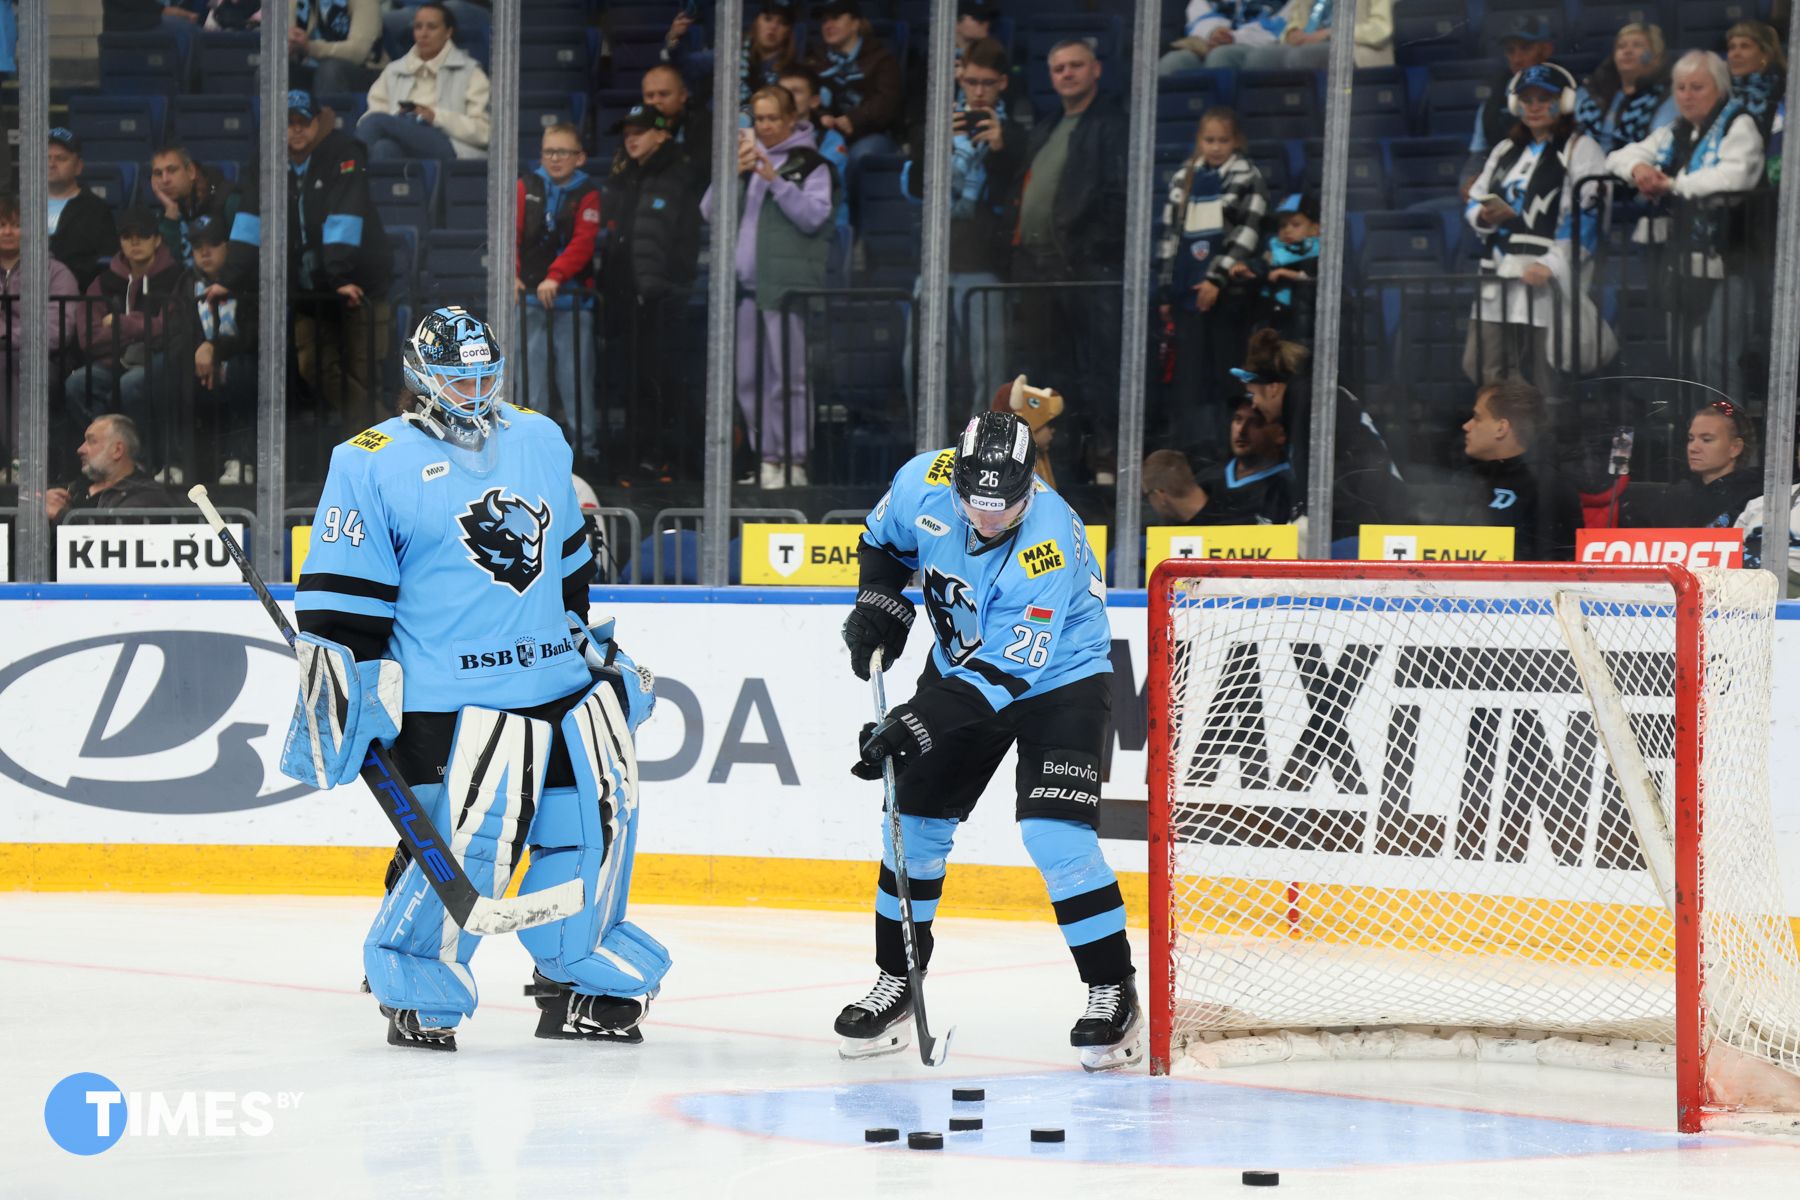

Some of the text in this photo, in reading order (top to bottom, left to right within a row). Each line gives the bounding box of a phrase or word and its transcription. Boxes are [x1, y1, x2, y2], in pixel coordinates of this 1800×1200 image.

[353, 438, 381, 450] LINE
[361, 430, 388, 442] MAX
[928, 453, 950, 481] LINE
[979, 470, 999, 488] 26
[321, 506, 366, 548] 94
[921, 517, 942, 533] МИР
[68, 538, 230, 569] KHL.RU
[811, 546, 860, 565] БАН
[1022, 542, 1055, 564] MAX
[1032, 554, 1062, 576] LINE
[459, 637, 574, 670] BSB Bank
[1003, 624, 1052, 668] 26
[632, 676, 801, 786] DA
[1043, 761, 1098, 782] Belavia
[363, 744, 457, 883] TRUE
[391, 873, 431, 942] TRU
